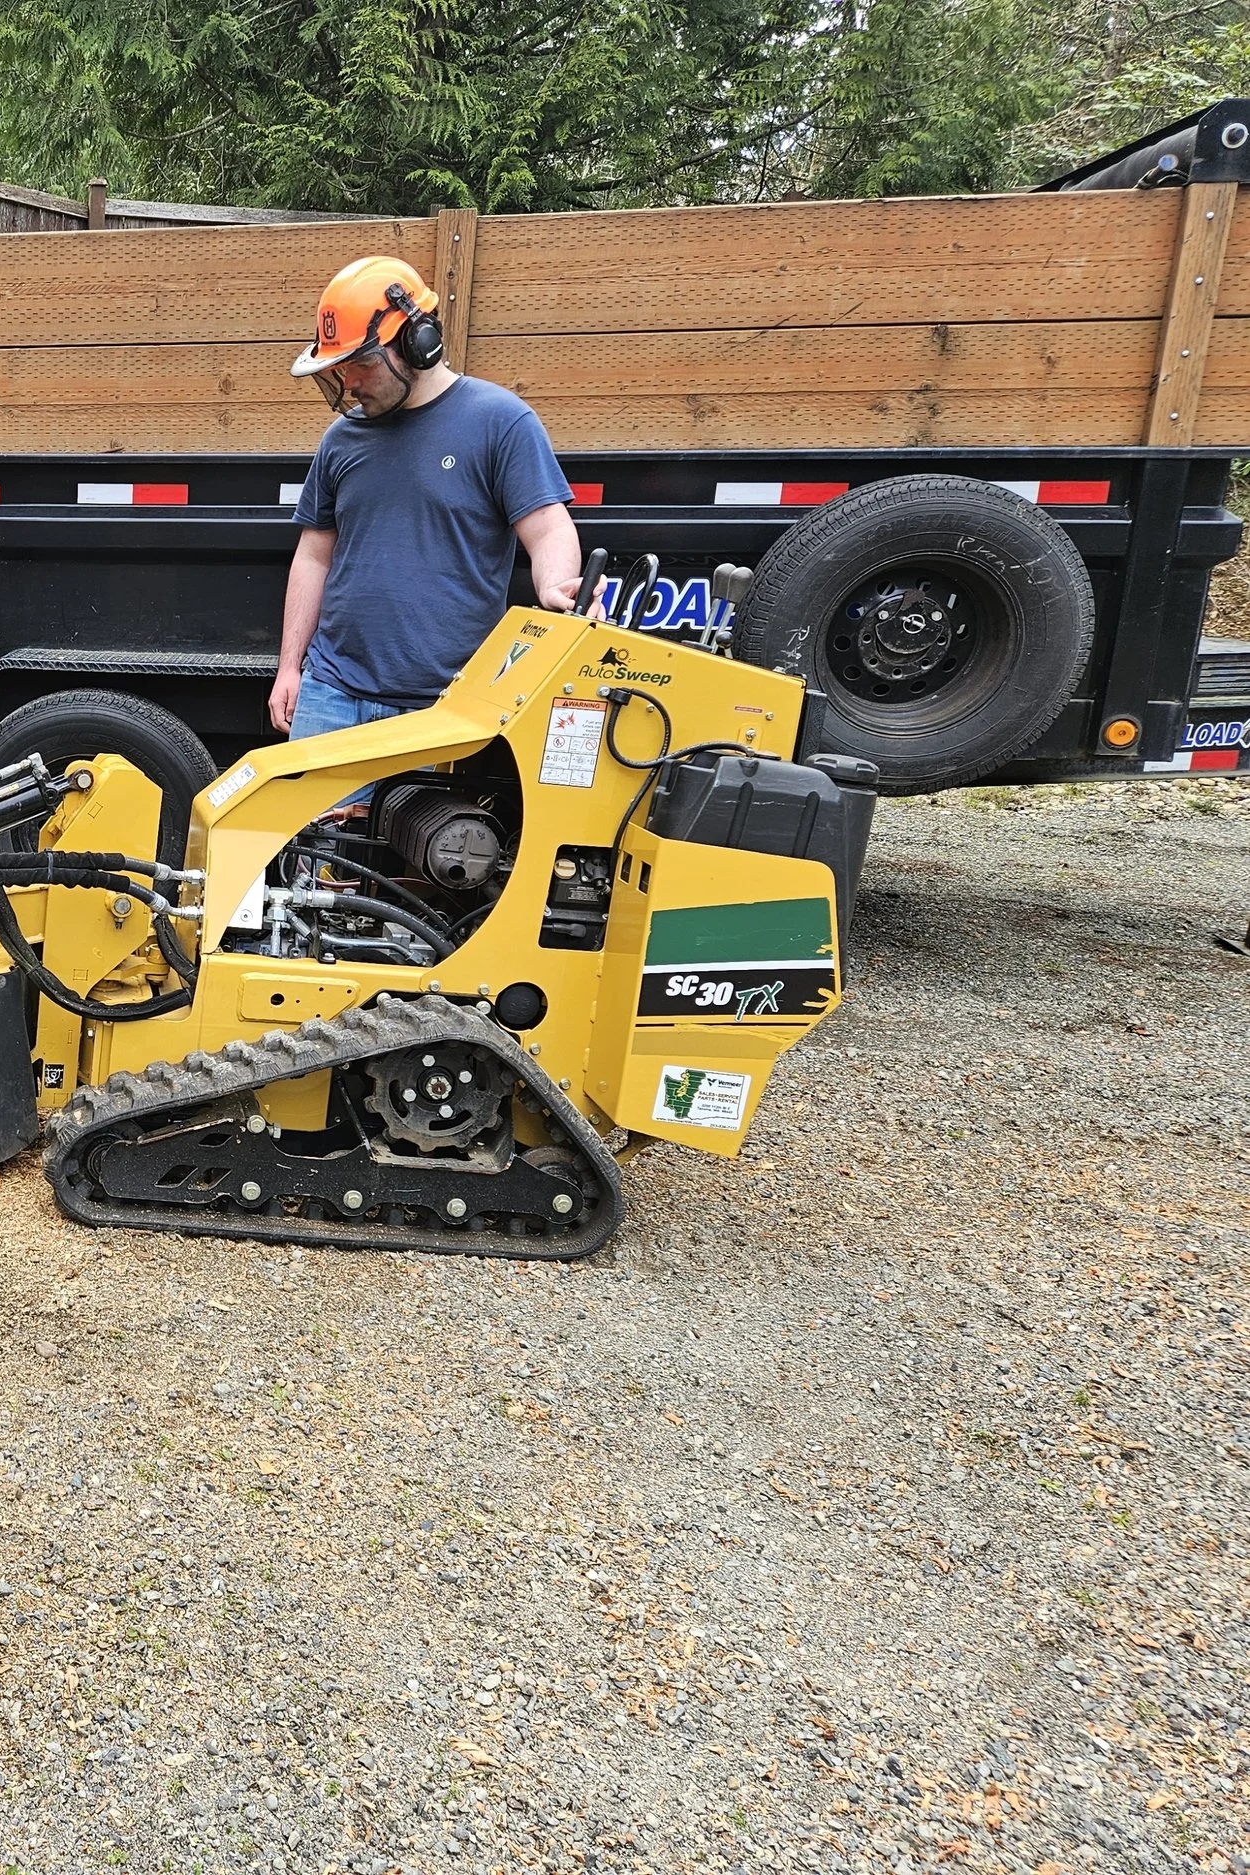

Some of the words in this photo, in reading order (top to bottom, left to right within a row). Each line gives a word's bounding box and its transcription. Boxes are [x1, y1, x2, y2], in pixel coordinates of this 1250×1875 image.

[519, 619, 549, 639] Vermeer
[568, 701, 600, 709] WARNING
[1180, 721, 1243, 748] LOAD
[734, 980, 785, 1022] TX
